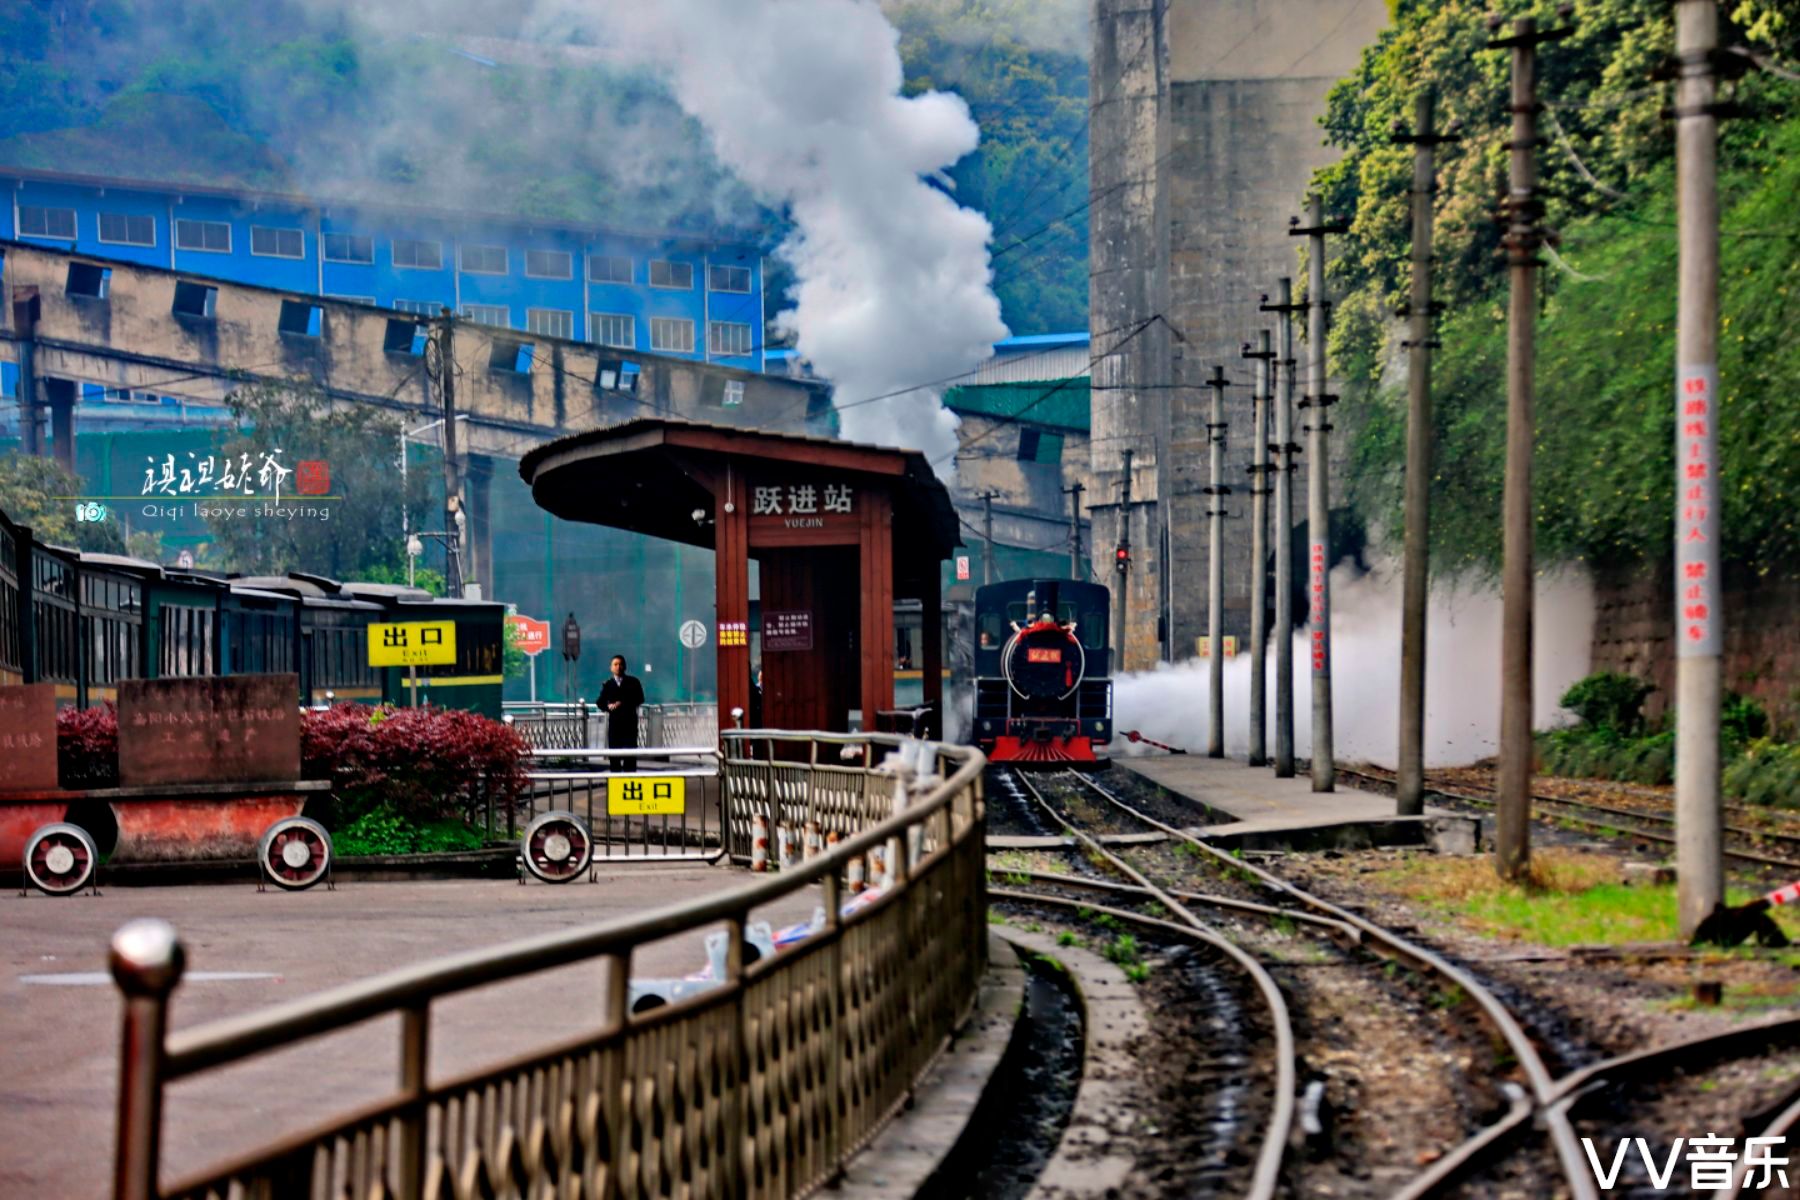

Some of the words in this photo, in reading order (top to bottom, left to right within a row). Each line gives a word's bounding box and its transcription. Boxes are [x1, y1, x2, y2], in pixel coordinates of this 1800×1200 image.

[753, 484, 853, 514] 跃进站
[784, 518, 824, 528] YUEJIN
[384, 626, 442, 647] 出口
[623, 781, 671, 801] 出口
